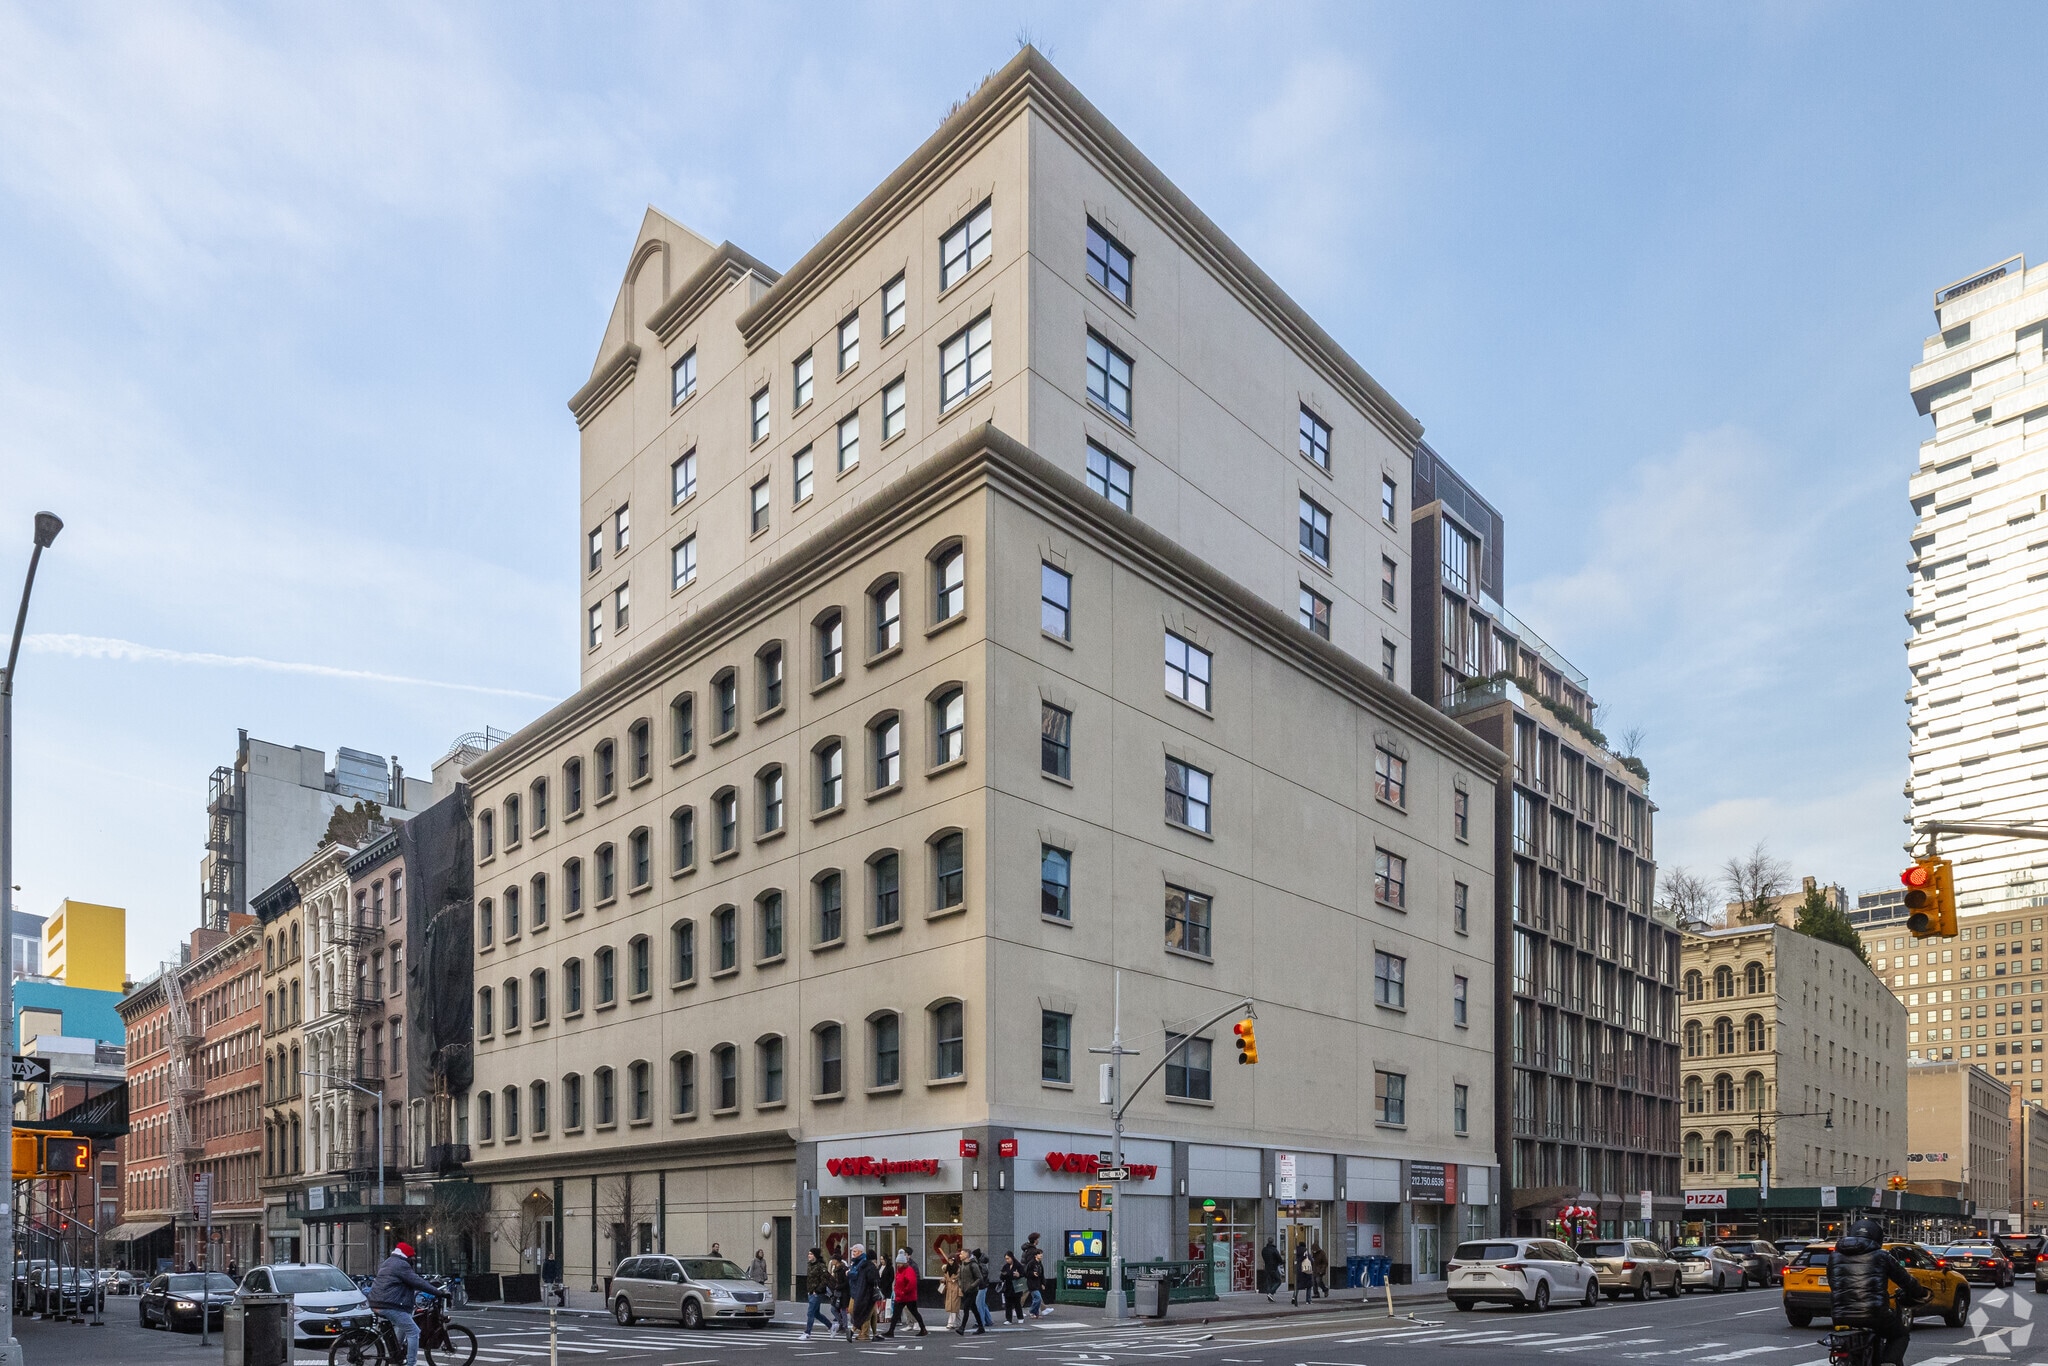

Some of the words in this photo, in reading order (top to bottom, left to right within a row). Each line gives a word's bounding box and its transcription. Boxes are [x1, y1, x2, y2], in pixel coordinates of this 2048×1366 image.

[75, 1145, 88, 1168] 2
[840, 1155, 874, 1177] CVS
[871, 1158, 939, 1178] pharmacy
[1064, 1152, 1100, 1174] CVS
[1686, 1194, 1725, 1204] PIZZA
